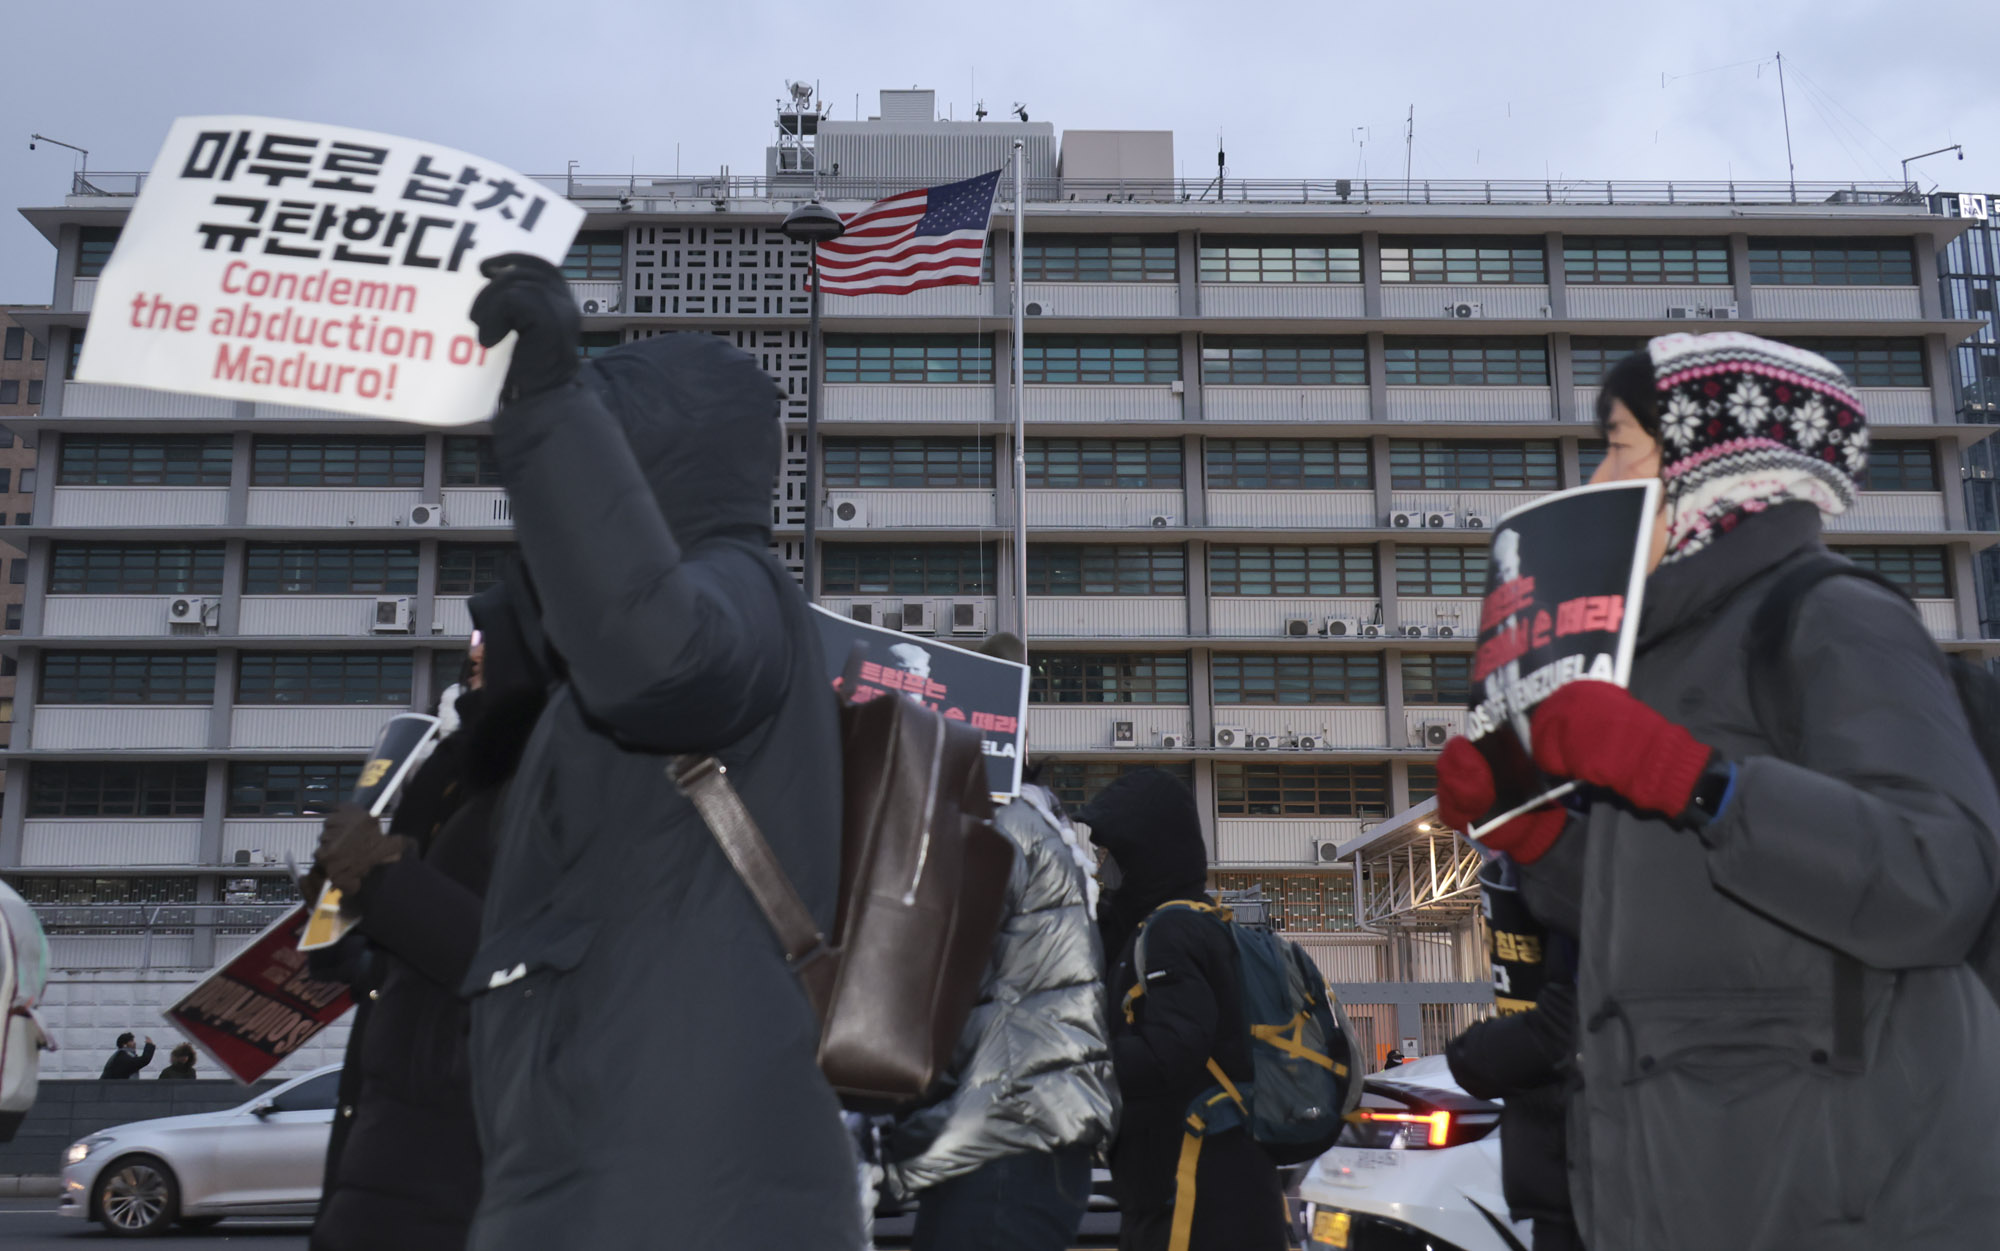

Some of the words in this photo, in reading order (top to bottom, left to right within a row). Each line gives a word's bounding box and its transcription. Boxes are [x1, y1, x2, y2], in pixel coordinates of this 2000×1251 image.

[179, 131, 389, 194] 마두로
[400, 155, 547, 232] 납치
[198, 195, 477, 272] 규탄한다
[221, 261, 417, 314] Condemn
[130, 293, 199, 332] the
[210, 303, 434, 361] abduction
[212, 345, 399, 401] Maduro!
[861, 661, 947, 699] 트럼프는
